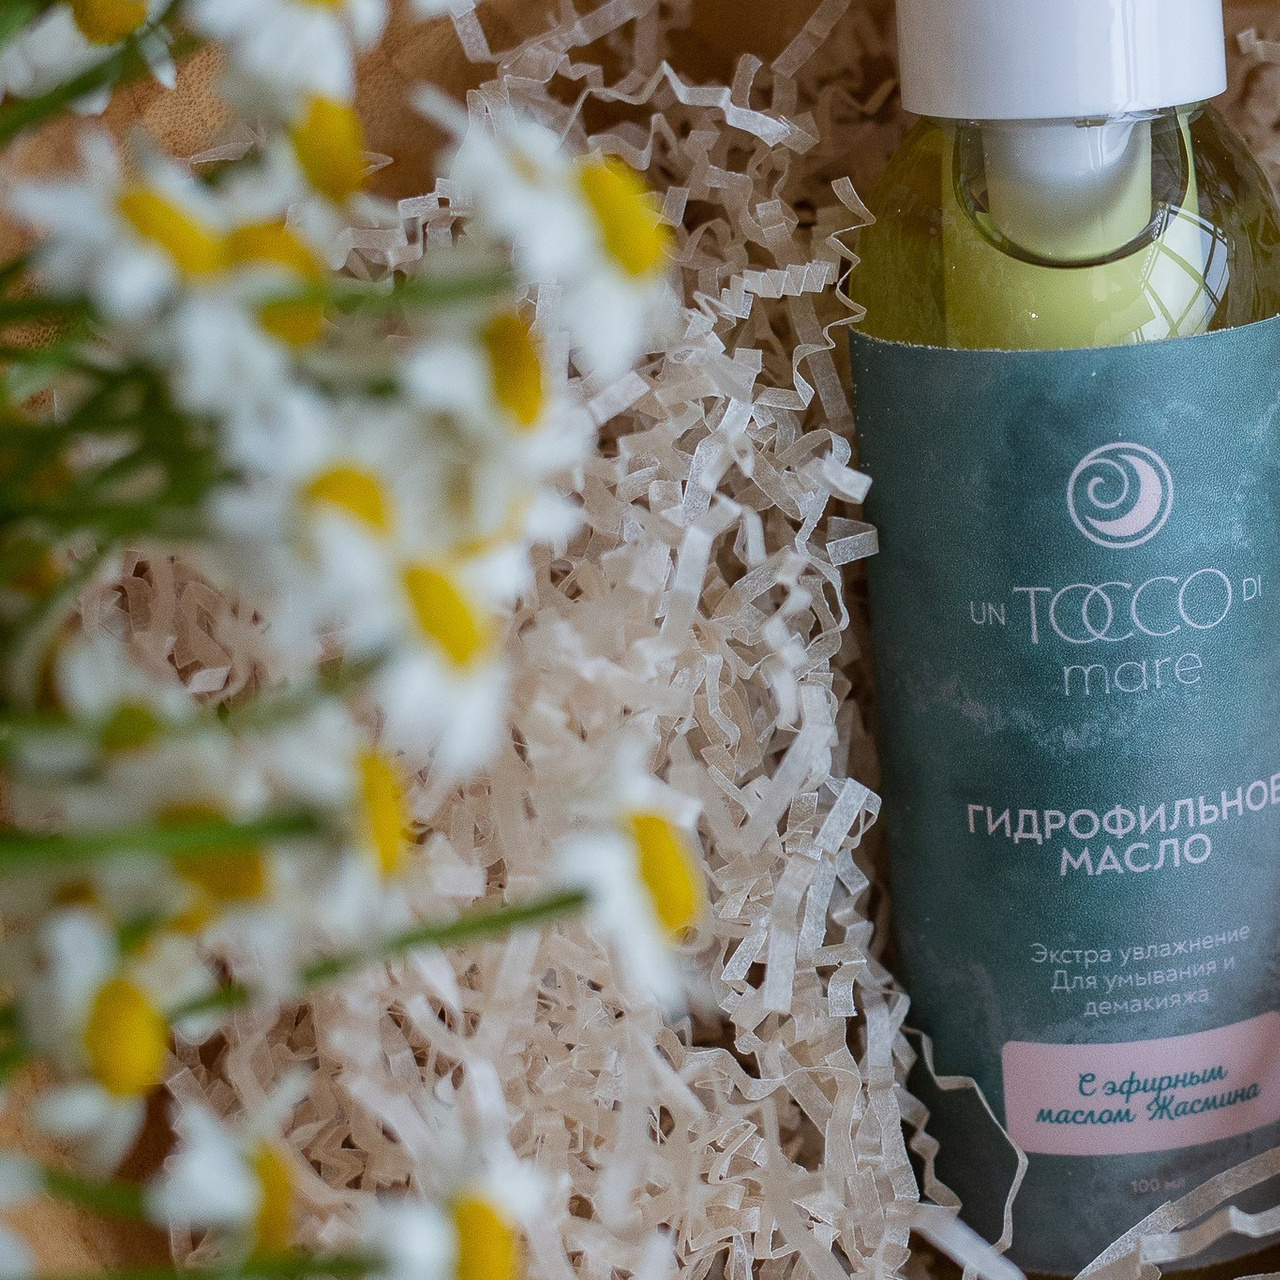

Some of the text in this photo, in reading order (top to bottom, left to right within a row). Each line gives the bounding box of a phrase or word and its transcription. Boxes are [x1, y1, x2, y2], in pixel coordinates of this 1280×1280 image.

[969, 568, 1263, 644] UN TOCCO DI
[1063, 652, 1203, 696] mare
[1060, 833, 1213, 877] МАСЛО
[1030, 924, 1251, 970] Экстра увлажнение
[1050, 954, 1236, 994] Для умывания и
[1083, 988, 1210, 1018] демакияжа
[1035, 1081, 1261, 1126] маслом Жасмина
[1078, 1064, 1229, 1103] С эфирным
